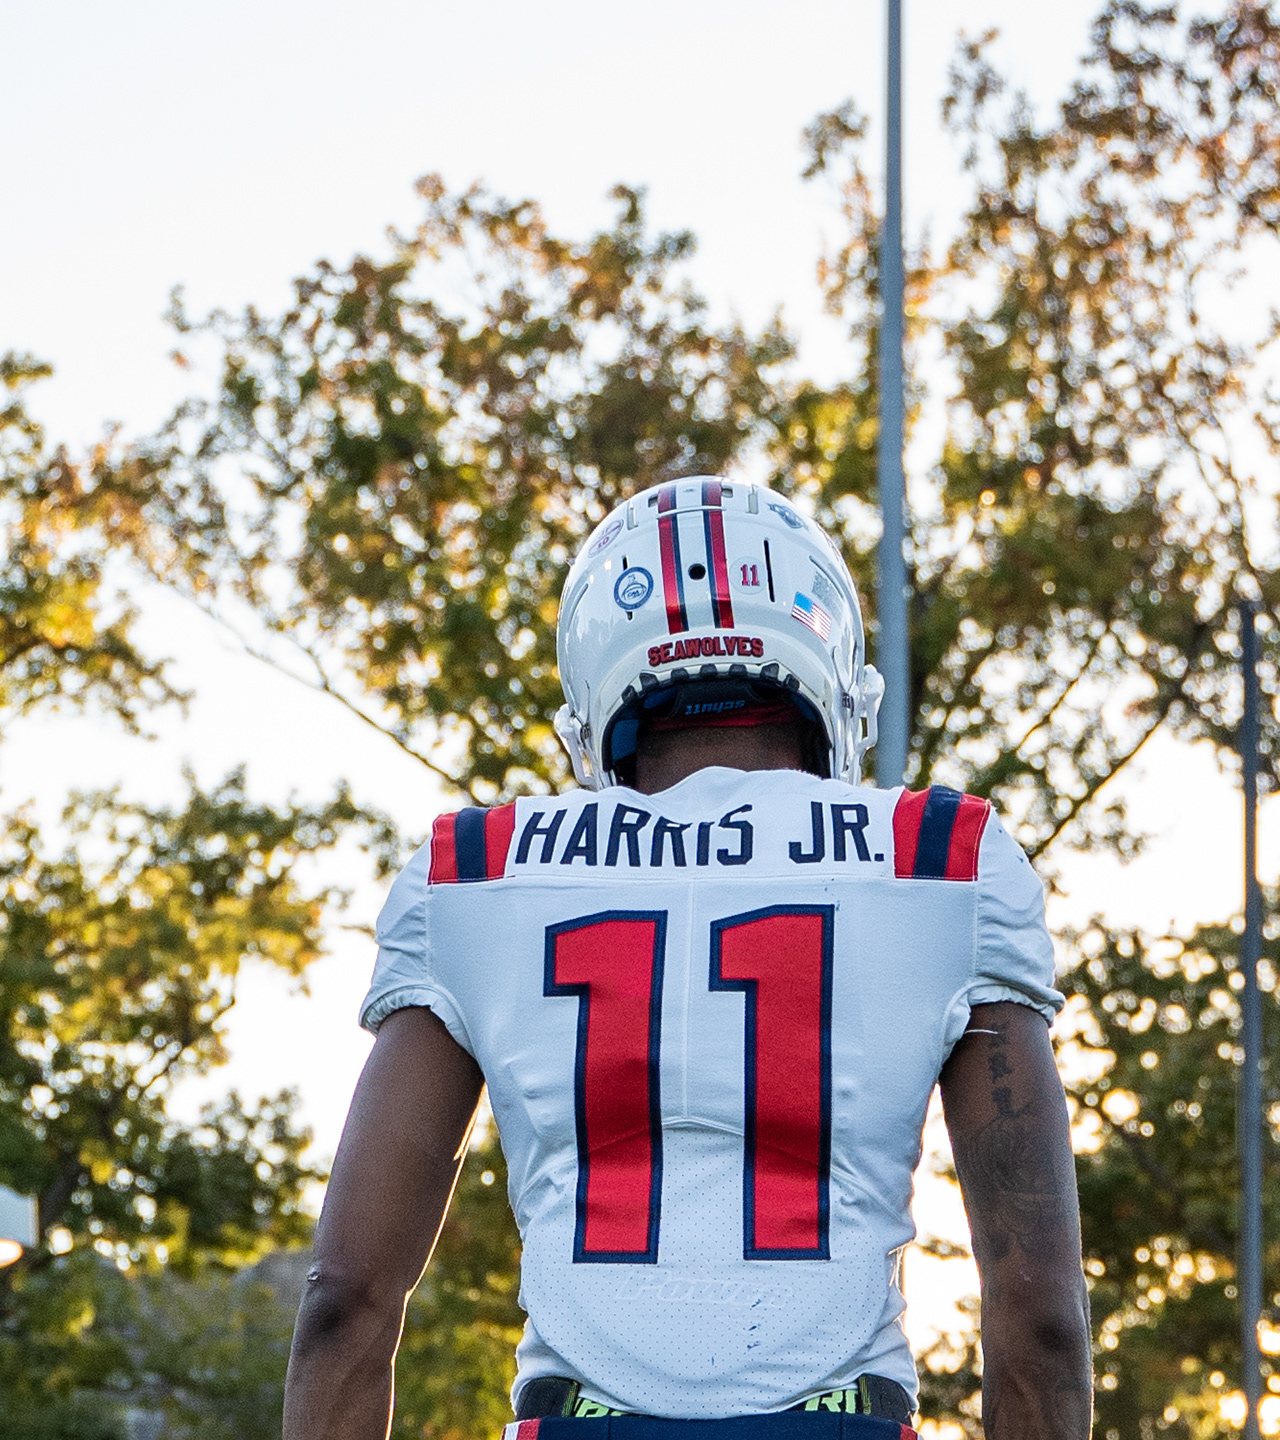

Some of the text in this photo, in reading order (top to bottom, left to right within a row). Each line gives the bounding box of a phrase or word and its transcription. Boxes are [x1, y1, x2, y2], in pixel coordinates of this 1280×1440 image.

[740, 564, 760, 586] 11
[648, 636, 764, 667] SEAWOLVES
[685, 699, 745, 715] schutt
[515, 802, 885, 867] HARRIS JR.
[543, 904, 835, 1264] 11
